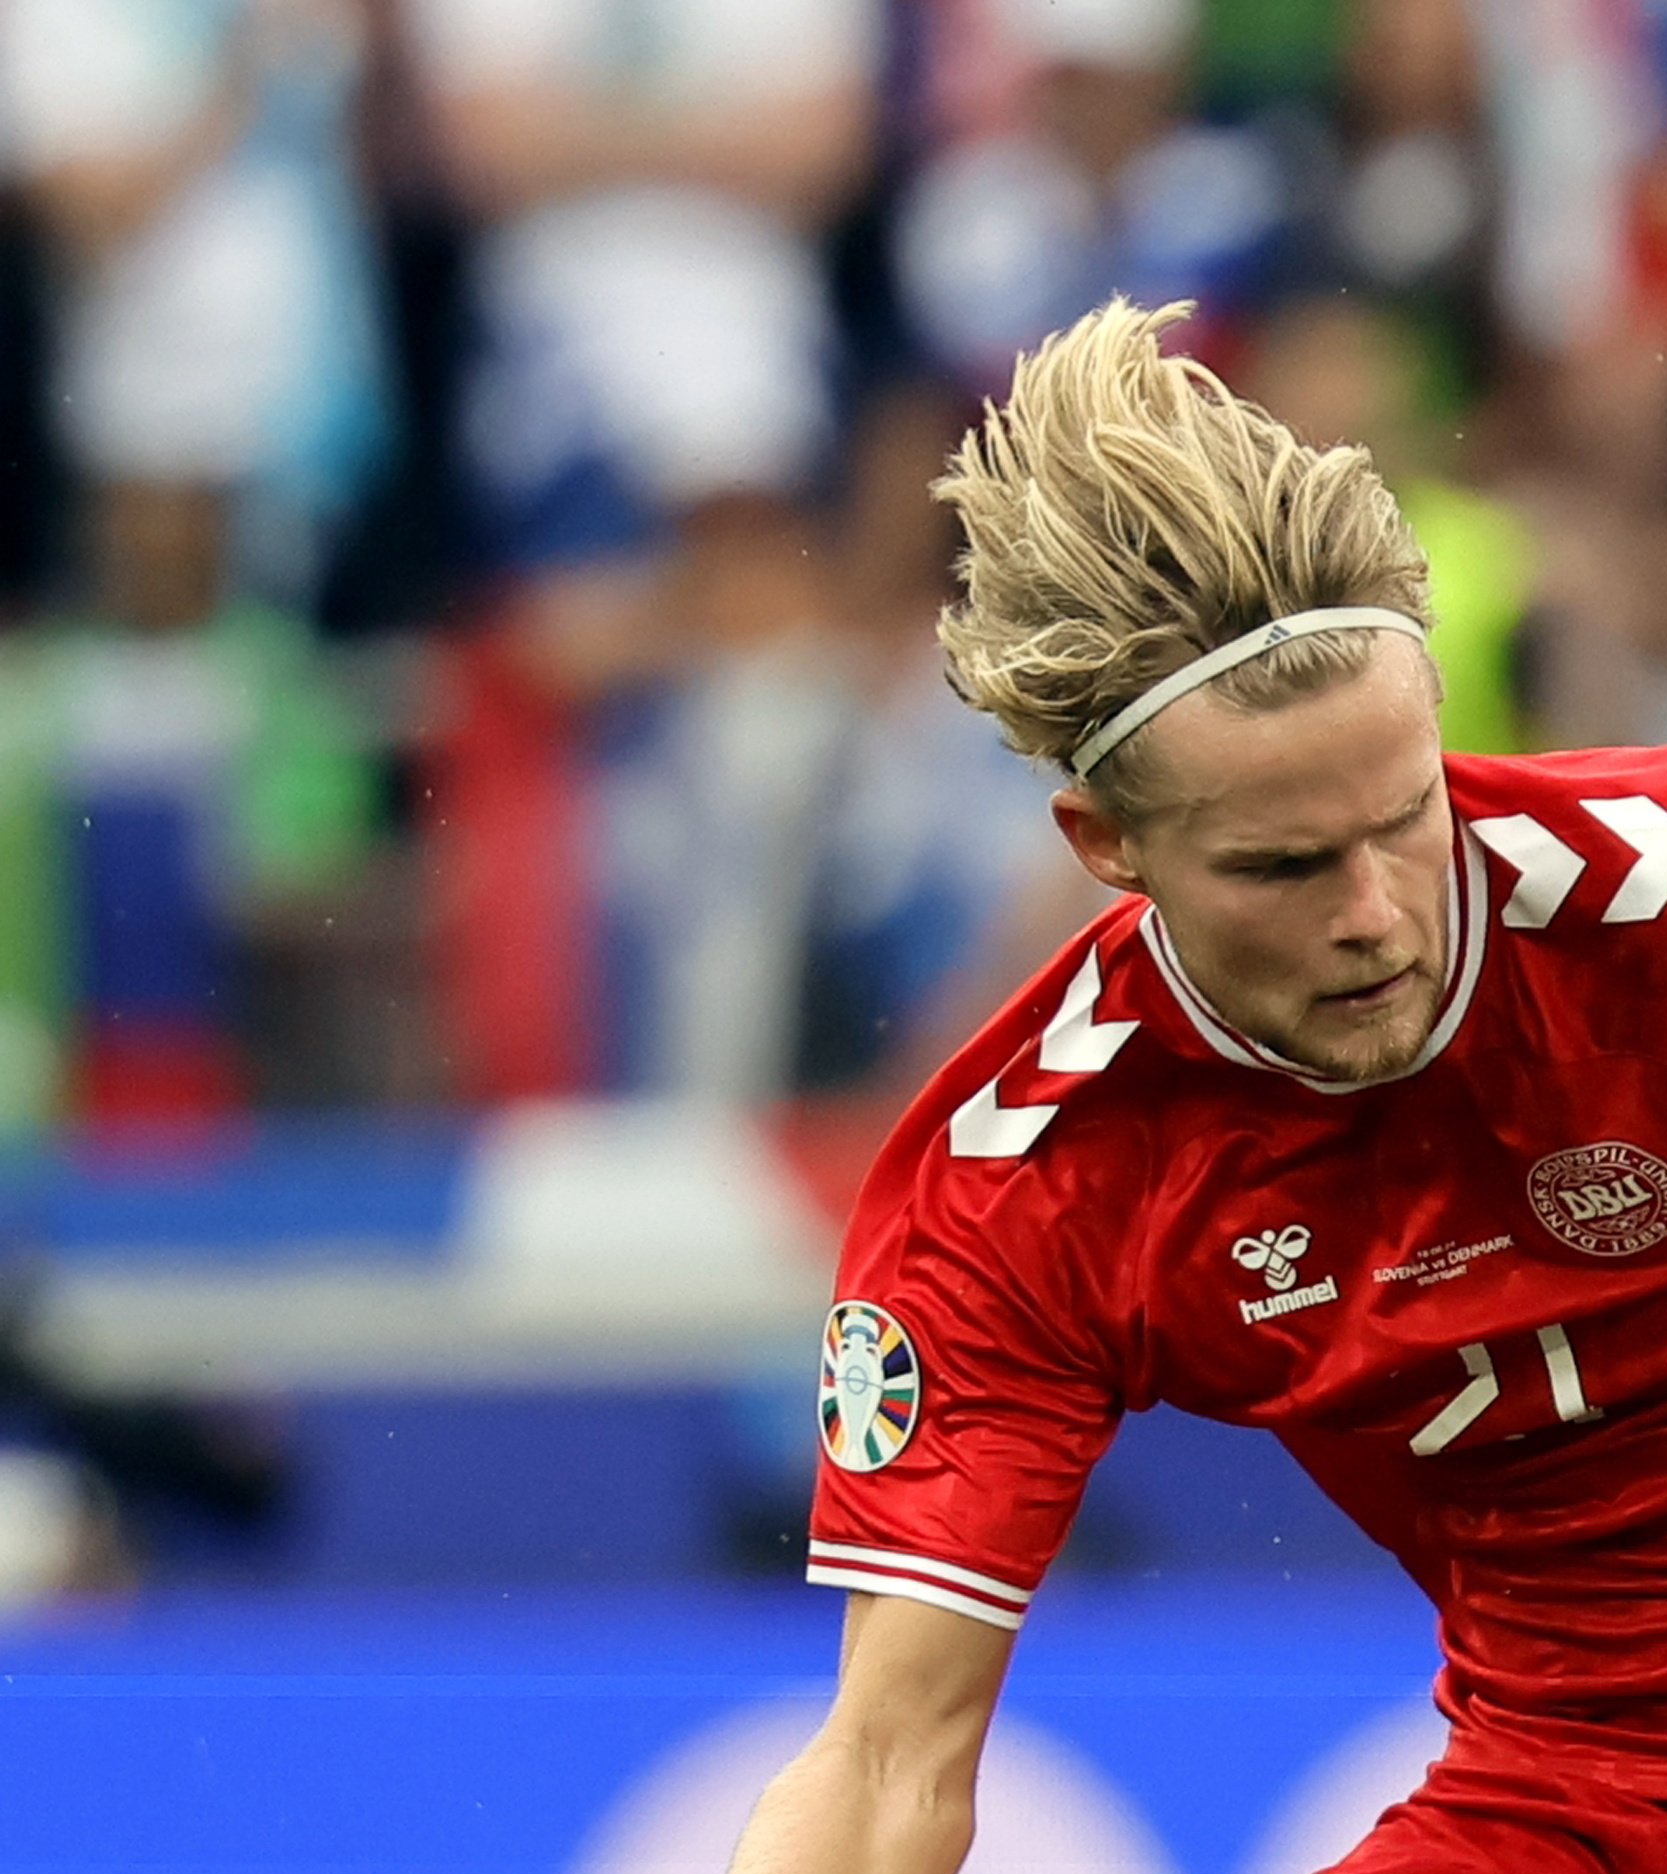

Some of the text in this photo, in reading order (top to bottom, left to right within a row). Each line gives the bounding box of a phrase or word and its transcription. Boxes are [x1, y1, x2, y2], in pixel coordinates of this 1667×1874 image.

[1533, 1187, 1599, 1250] DANSK
[1557, 1174, 1653, 1221] DBU
[1448, 1234, 1514, 1264] DENMARK
[1239, 1275, 1338, 1325] hummel
